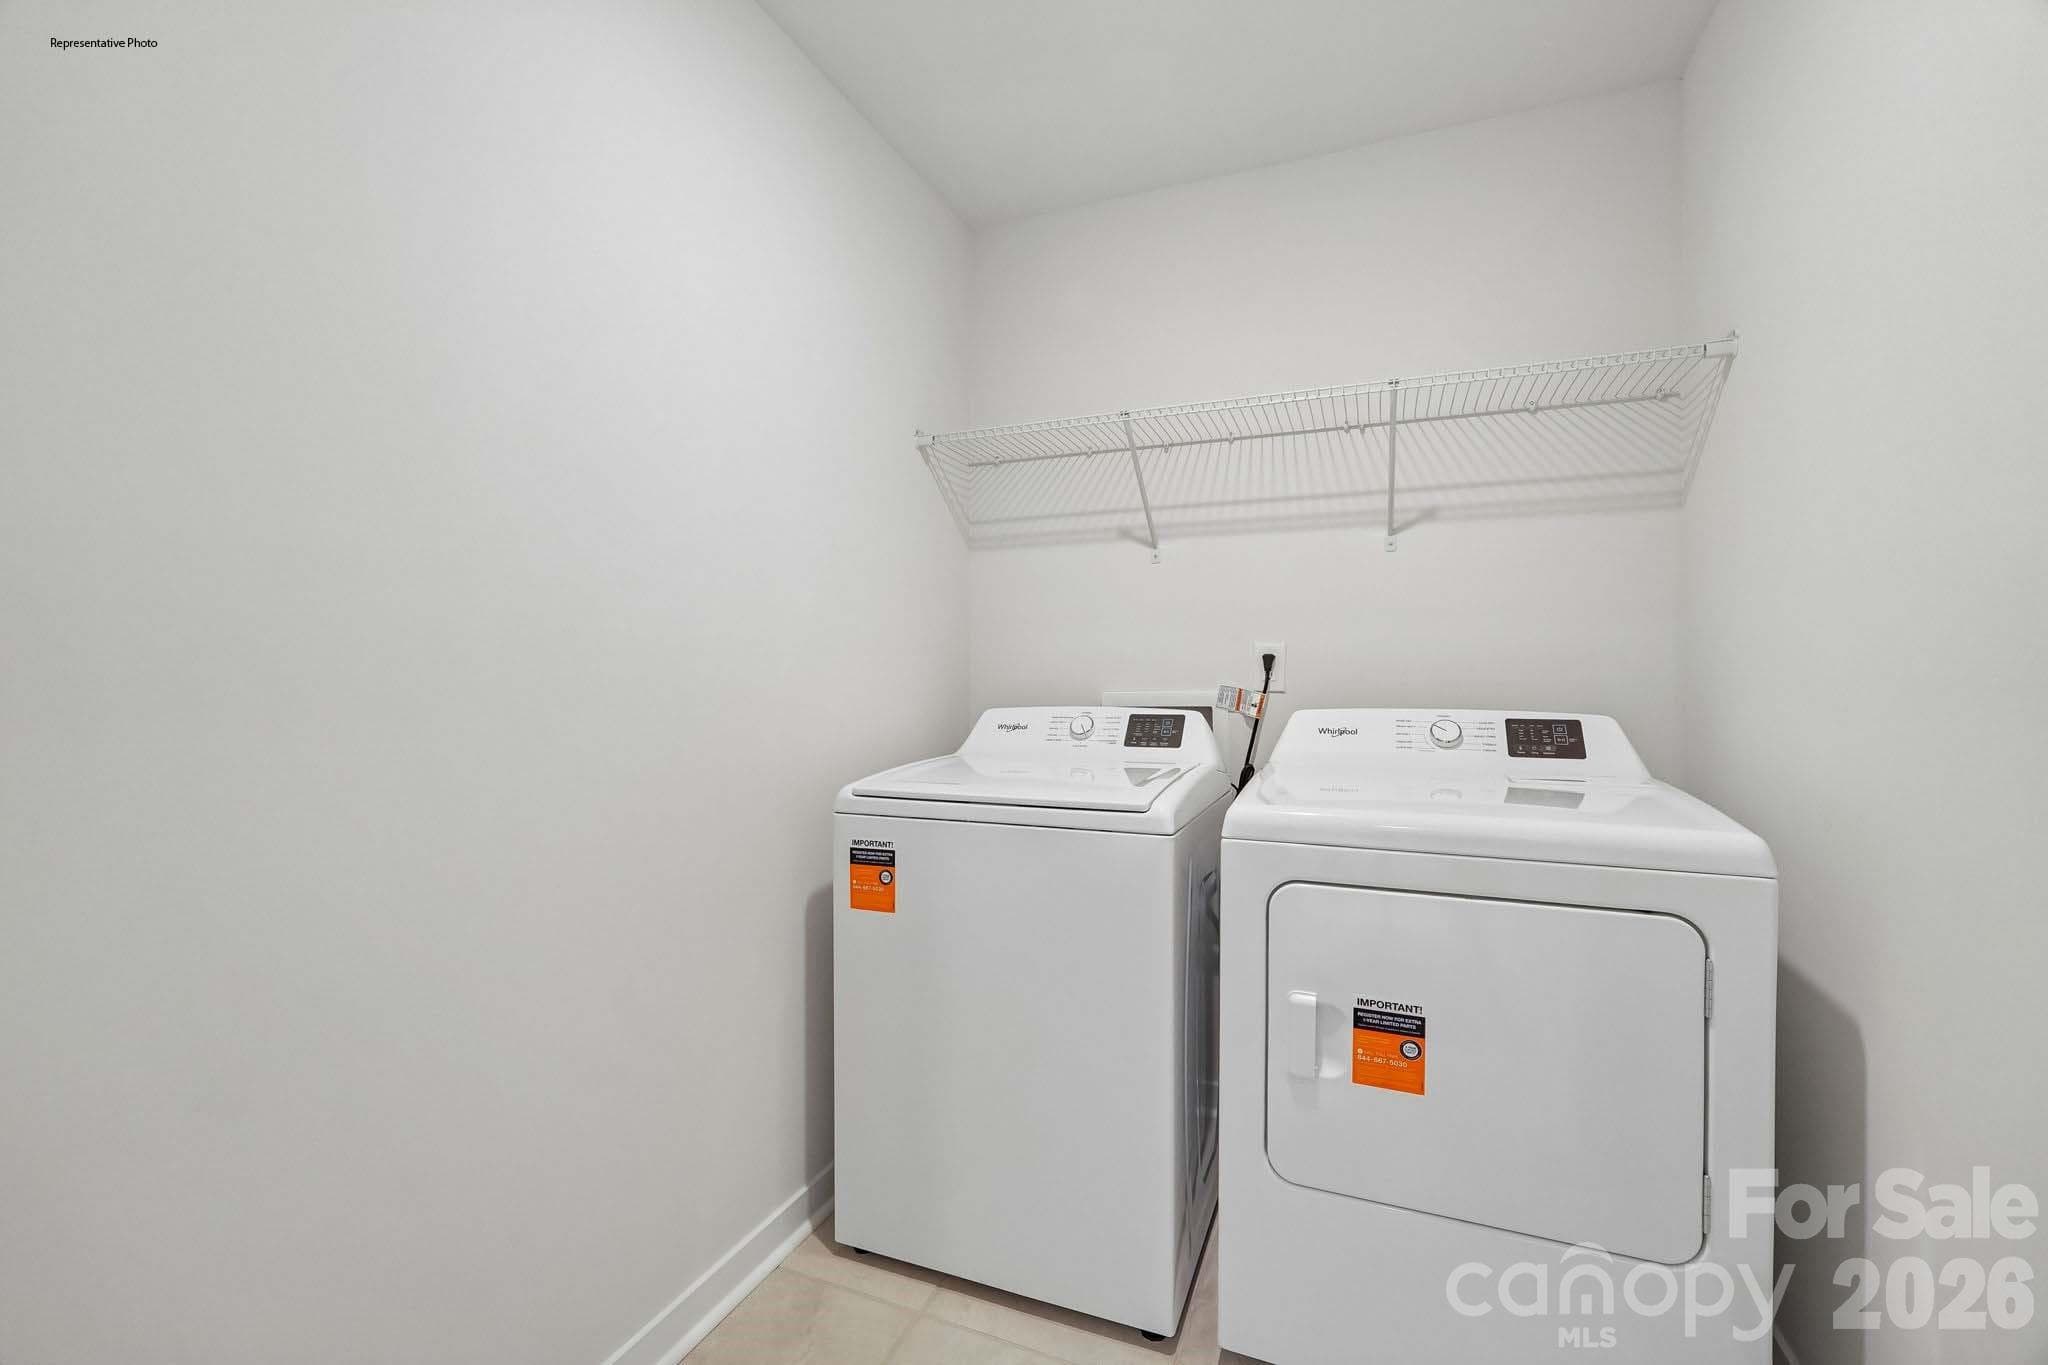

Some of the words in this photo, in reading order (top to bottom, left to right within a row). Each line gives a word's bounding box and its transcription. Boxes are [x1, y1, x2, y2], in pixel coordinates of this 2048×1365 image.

[997, 723, 1029, 733] Whirlpool
[1318, 727, 1358, 737] Whirlpool
[851, 839, 894, 849] IMPORTANT!
[1356, 997, 1423, 1015] IMPORTANT!
